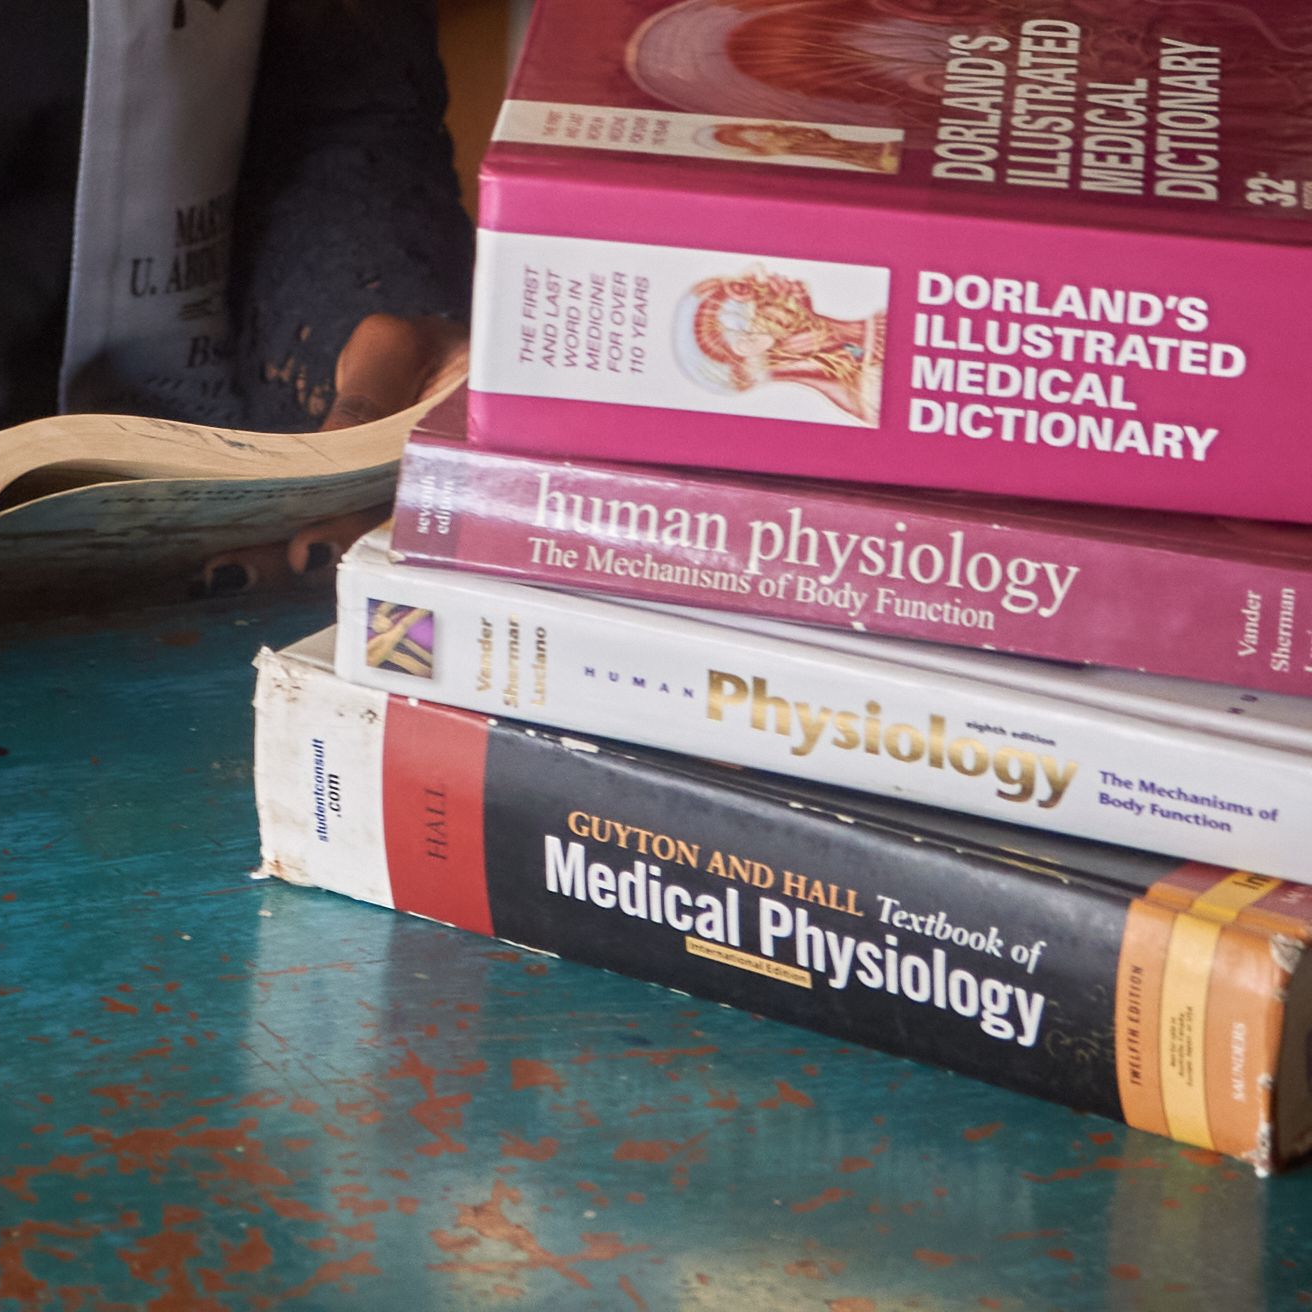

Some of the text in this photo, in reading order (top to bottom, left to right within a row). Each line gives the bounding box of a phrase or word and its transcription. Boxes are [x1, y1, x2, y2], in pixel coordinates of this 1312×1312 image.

[931, 34, 1010, 183] DORLAND'S
[1006, 19, 1082, 189] ILLUSTRATED
[1080, 77, 1149, 196] MEDICAL
[1154, 36, 1222, 202] DICTIONARY
[131, 258, 156, 297] U.
[519, 264, 540, 364] THE FIRST
[541, 270, 563, 368] AND LAST
[917, 270, 1210, 334] DORLAND'S
[564, 278, 583, 369] WORD IN
[585, 273, 607, 372] MEDICINE
[607, 271, 629, 374] FOR OVER
[629, 275, 651, 375] 110 YEARS
[913, 312, 1247, 379] ILLUSTRATED
[910, 355, 1137, 412] MEDICAL
[907, 398, 1219, 463] DICTIONARY
[415, 476, 435, 535] seventh
[436, 479, 455, 535] edition
[529, 472, 1081, 618] human physiology
[527, 536, 995, 631] The Mechanisms of Body Function
[1237, 589, 1264, 658] Vander
[475, 616, 494, 693] Vander
[503, 613, 522, 709] Sherman
[530, 625, 548, 707] Luciano
[1271, 586, 1296, 673] Sherman
[584, 666, 695, 699] HUMAN
[707, 668, 1080, 810] Physiology
[966, 720, 1057, 747] eighth edition
[310, 738, 329, 843] studentconsult
[328, 772, 342, 818] .com
[425, 782, 448, 862] HALL
[1098, 791, 1232, 835] Body Function
[1099, 769, 1280, 823] The Mechanisms of
[566, 811, 1048, 975] GUYTON AND HALL Textbook of
[543, 834, 742, 949] Medical
[757, 897, 1046, 1048] Physiology
[688, 939, 811, 986] International Edition
[1127, 964, 1144, 1086] TWELFTH EDITION
[1231, 1022, 1247, 1104] SAUNDERS
